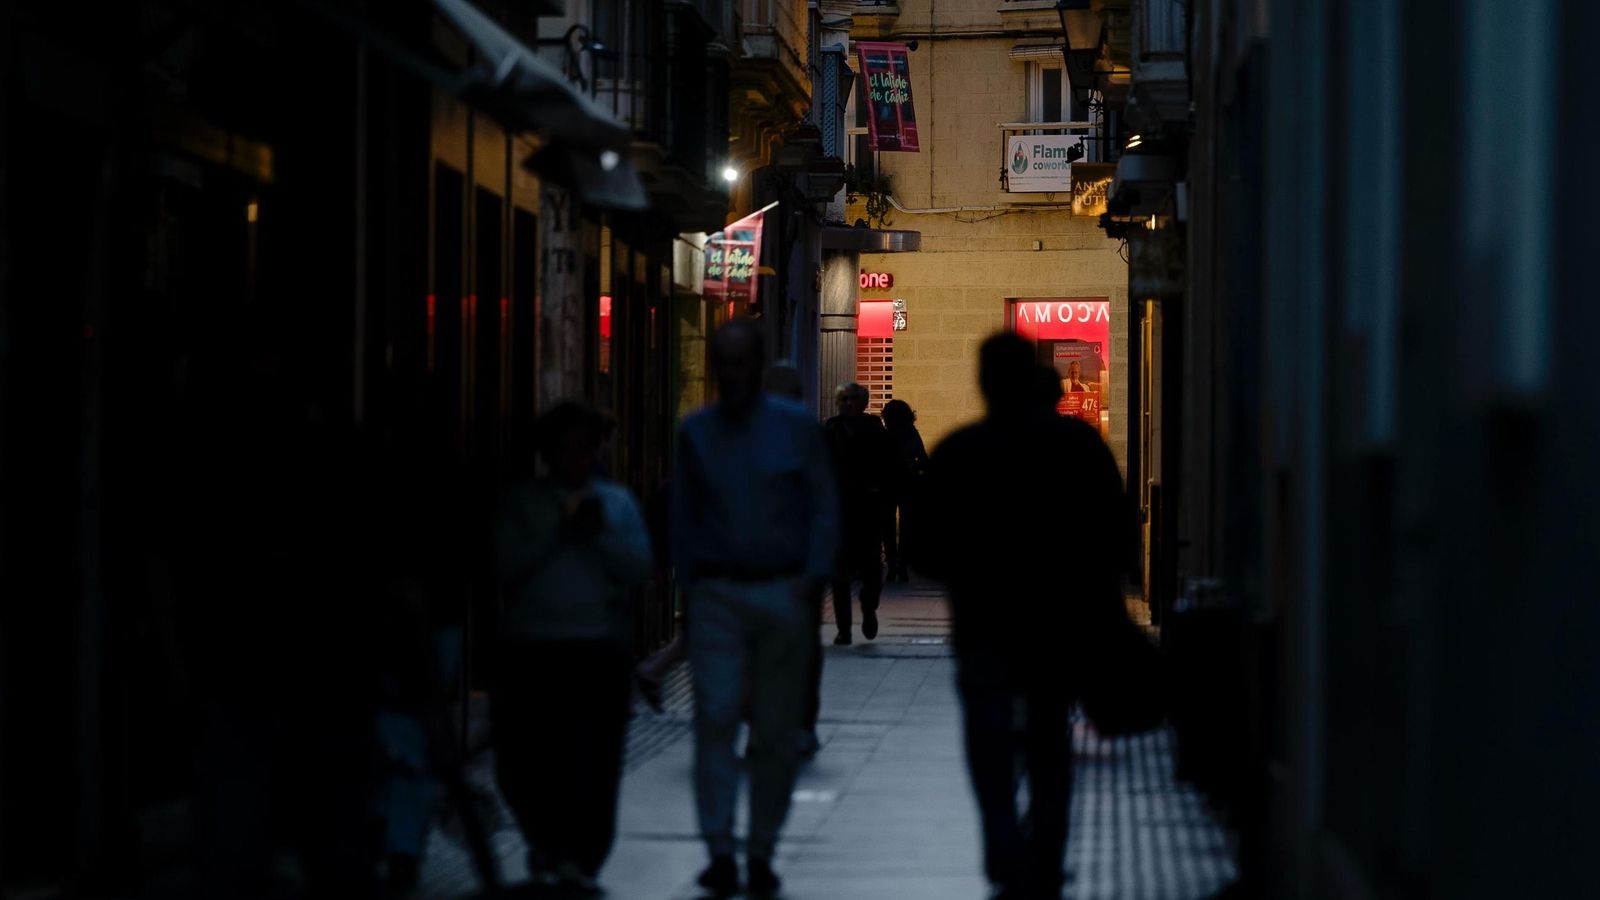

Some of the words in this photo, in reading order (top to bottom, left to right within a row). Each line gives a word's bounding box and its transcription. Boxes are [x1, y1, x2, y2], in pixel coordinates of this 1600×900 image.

[881, 71, 908, 89] latido
[870, 89, 883, 101] de
[884, 88, 910, 104] Cádiz
[1033, 144, 1066, 159] Flam
[708, 264, 722, 276] de
